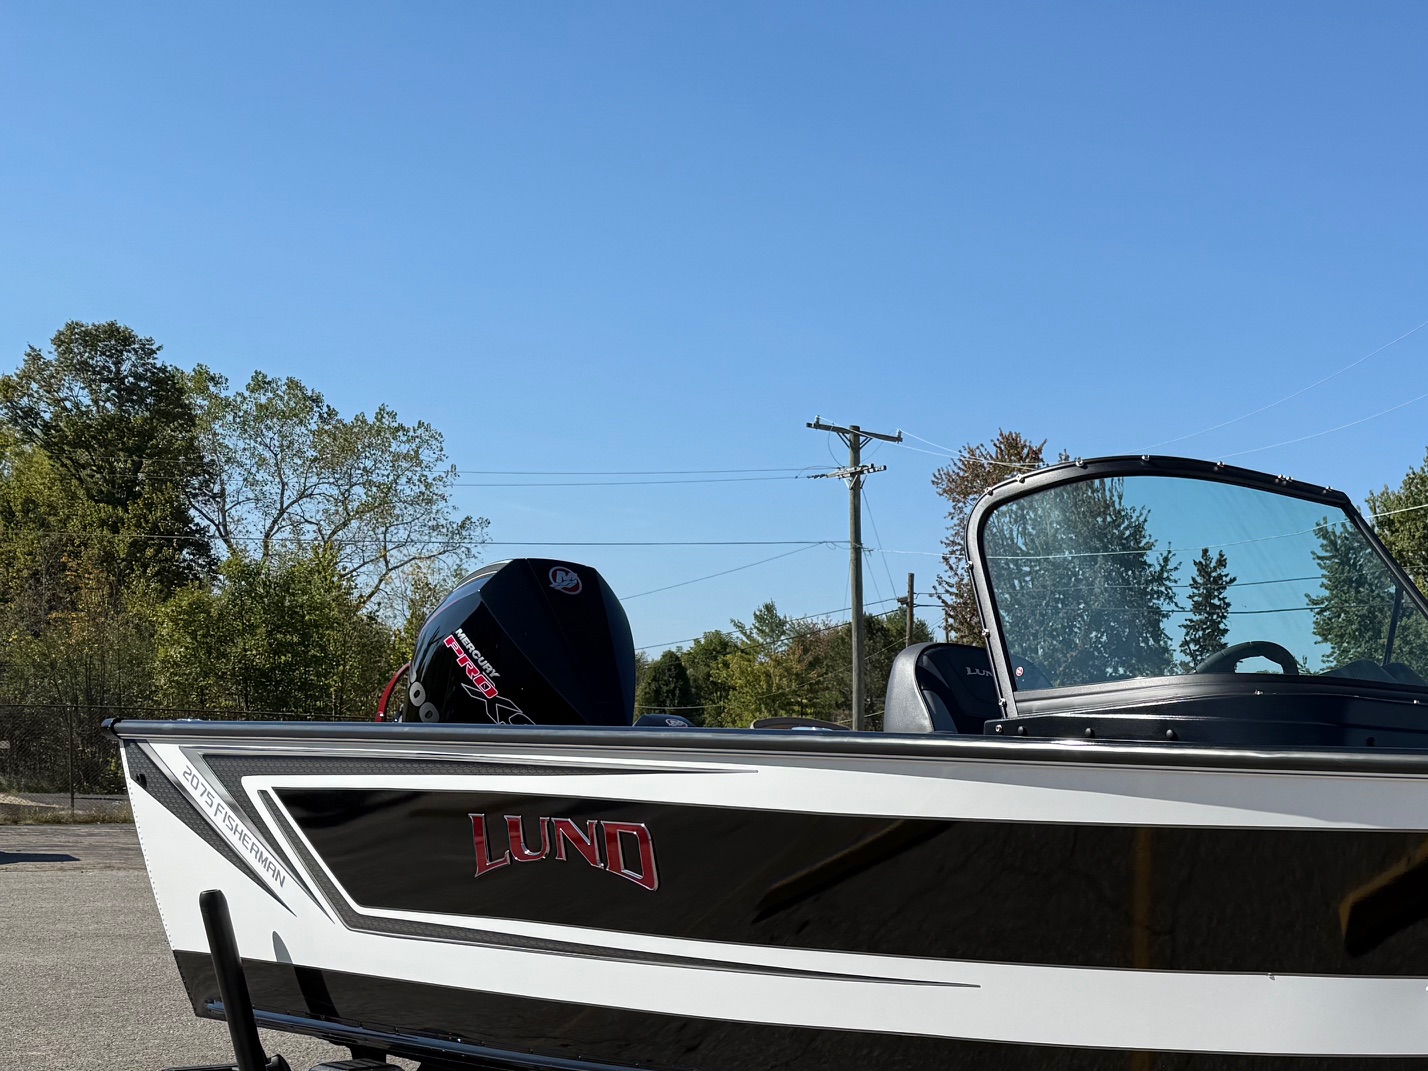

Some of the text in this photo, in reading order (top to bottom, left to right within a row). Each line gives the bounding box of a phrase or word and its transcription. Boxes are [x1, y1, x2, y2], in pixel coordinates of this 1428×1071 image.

[443, 634, 499, 699] PRO
[455, 628, 500, 678] MERCURY
[965, 666, 993, 677] LUN
[182, 764, 287, 888] 2075 FISHERMAN
[468, 813, 660, 891] LUND
